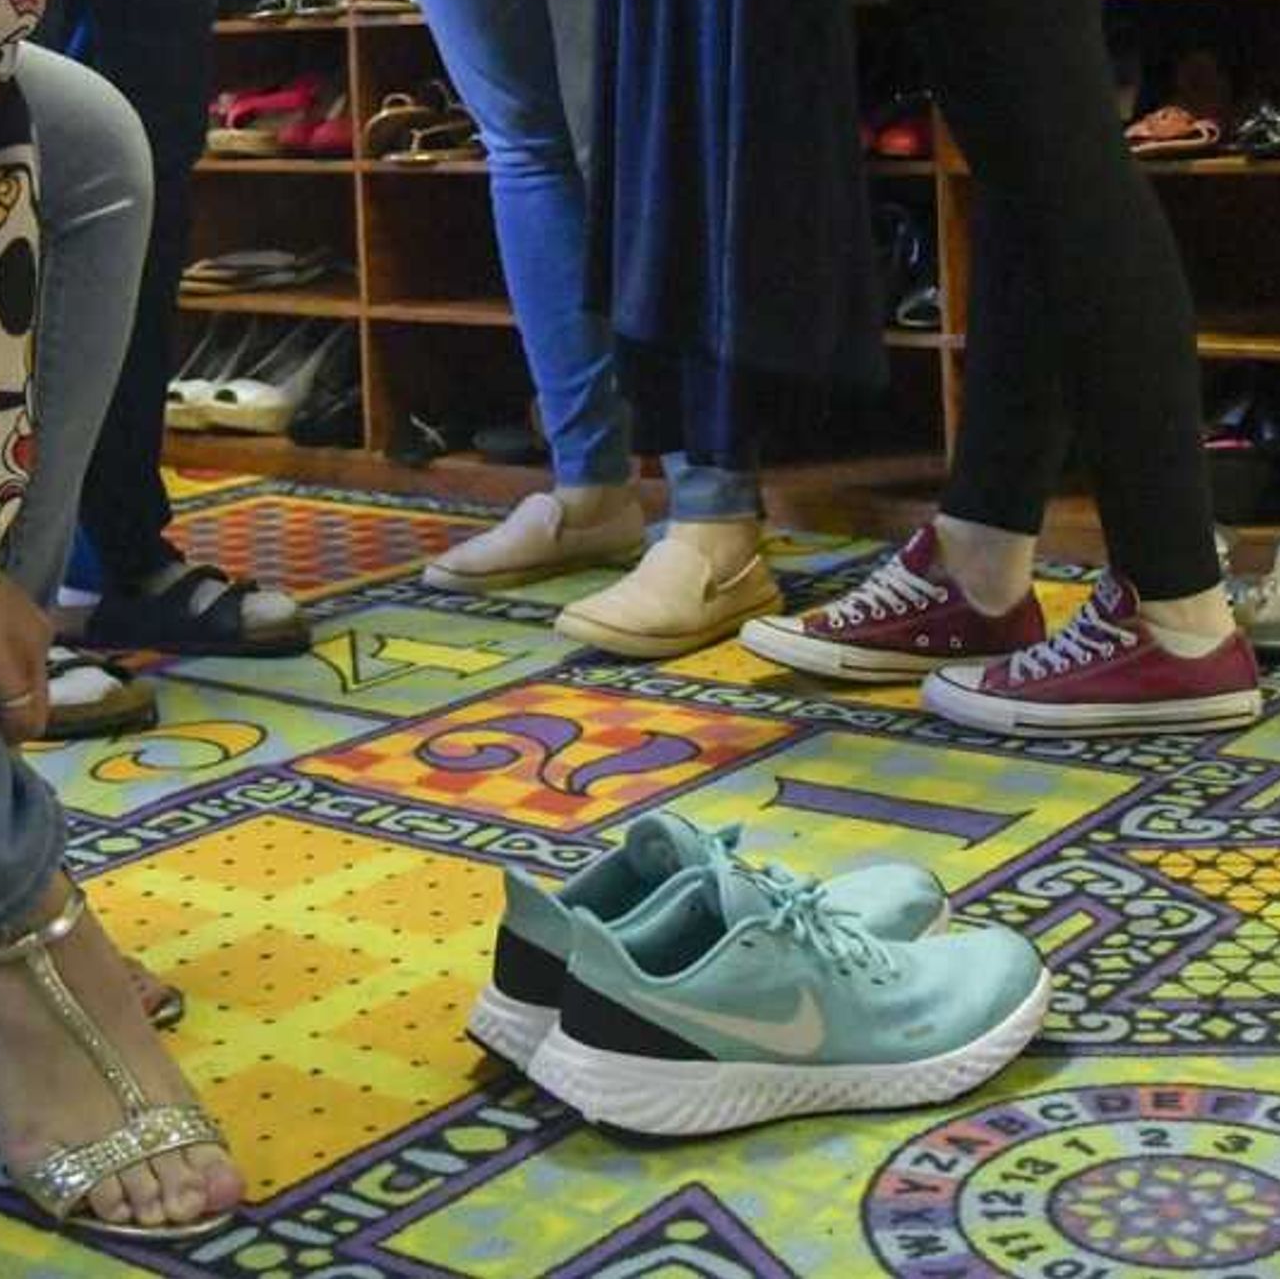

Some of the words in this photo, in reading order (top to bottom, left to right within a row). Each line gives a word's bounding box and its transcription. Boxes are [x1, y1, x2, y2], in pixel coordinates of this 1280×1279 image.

[414, 712, 703, 797] 2
[1097, 1095, 1130, 1112] D
[1153, 1093, 1184, 1108] E
[1040, 1103, 1076, 1120] C
[1141, 1128, 1170, 1147] 2
[1215, 1134, 1252, 1153] 3
[1065, 1138, 1096, 1155] 1
[913, 1153, 956, 1170] Z
[1002, 1157, 1058, 1183] 13
[896, 1180, 939, 1193] Y
[980, 1190, 1023, 1219] 12
